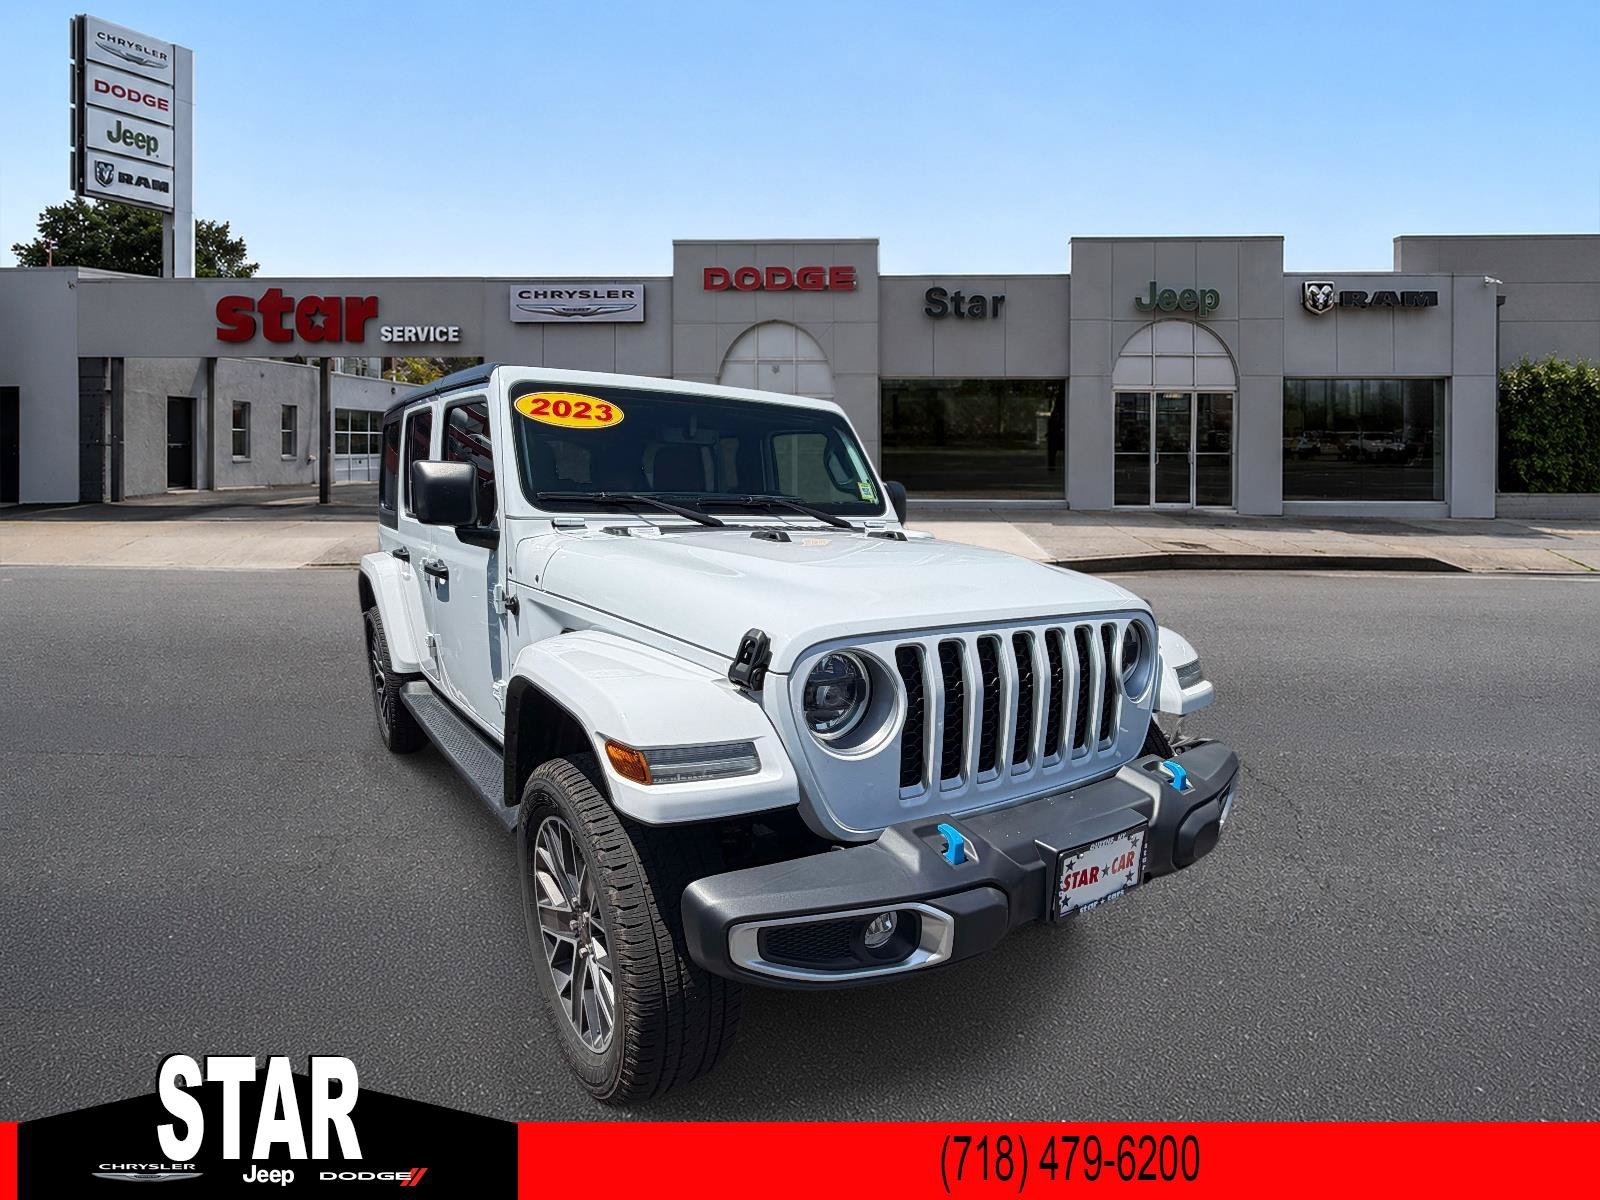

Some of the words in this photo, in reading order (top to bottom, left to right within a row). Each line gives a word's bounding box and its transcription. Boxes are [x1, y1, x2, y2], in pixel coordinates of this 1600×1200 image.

[97, 31, 168, 61] CHRYSLER
[94, 79, 169, 112] DODGE
[107, 120, 159, 156] Jeep
[118, 171, 169, 193] RAM
[703, 265, 857, 292] DODGE
[518, 290, 635, 299] CHRYSLER
[924, 286, 1006, 319] Star
[1135, 280, 1221, 316] Jeep
[1339, 290, 1439, 308] RAM
[215, 287, 379, 343] star
[380, 326, 461, 342] SERVICE
[530, 398, 613, 422] 2023
[1062, 866, 1100, 892] STAR
[1111, 850, 1136, 874] CAR
